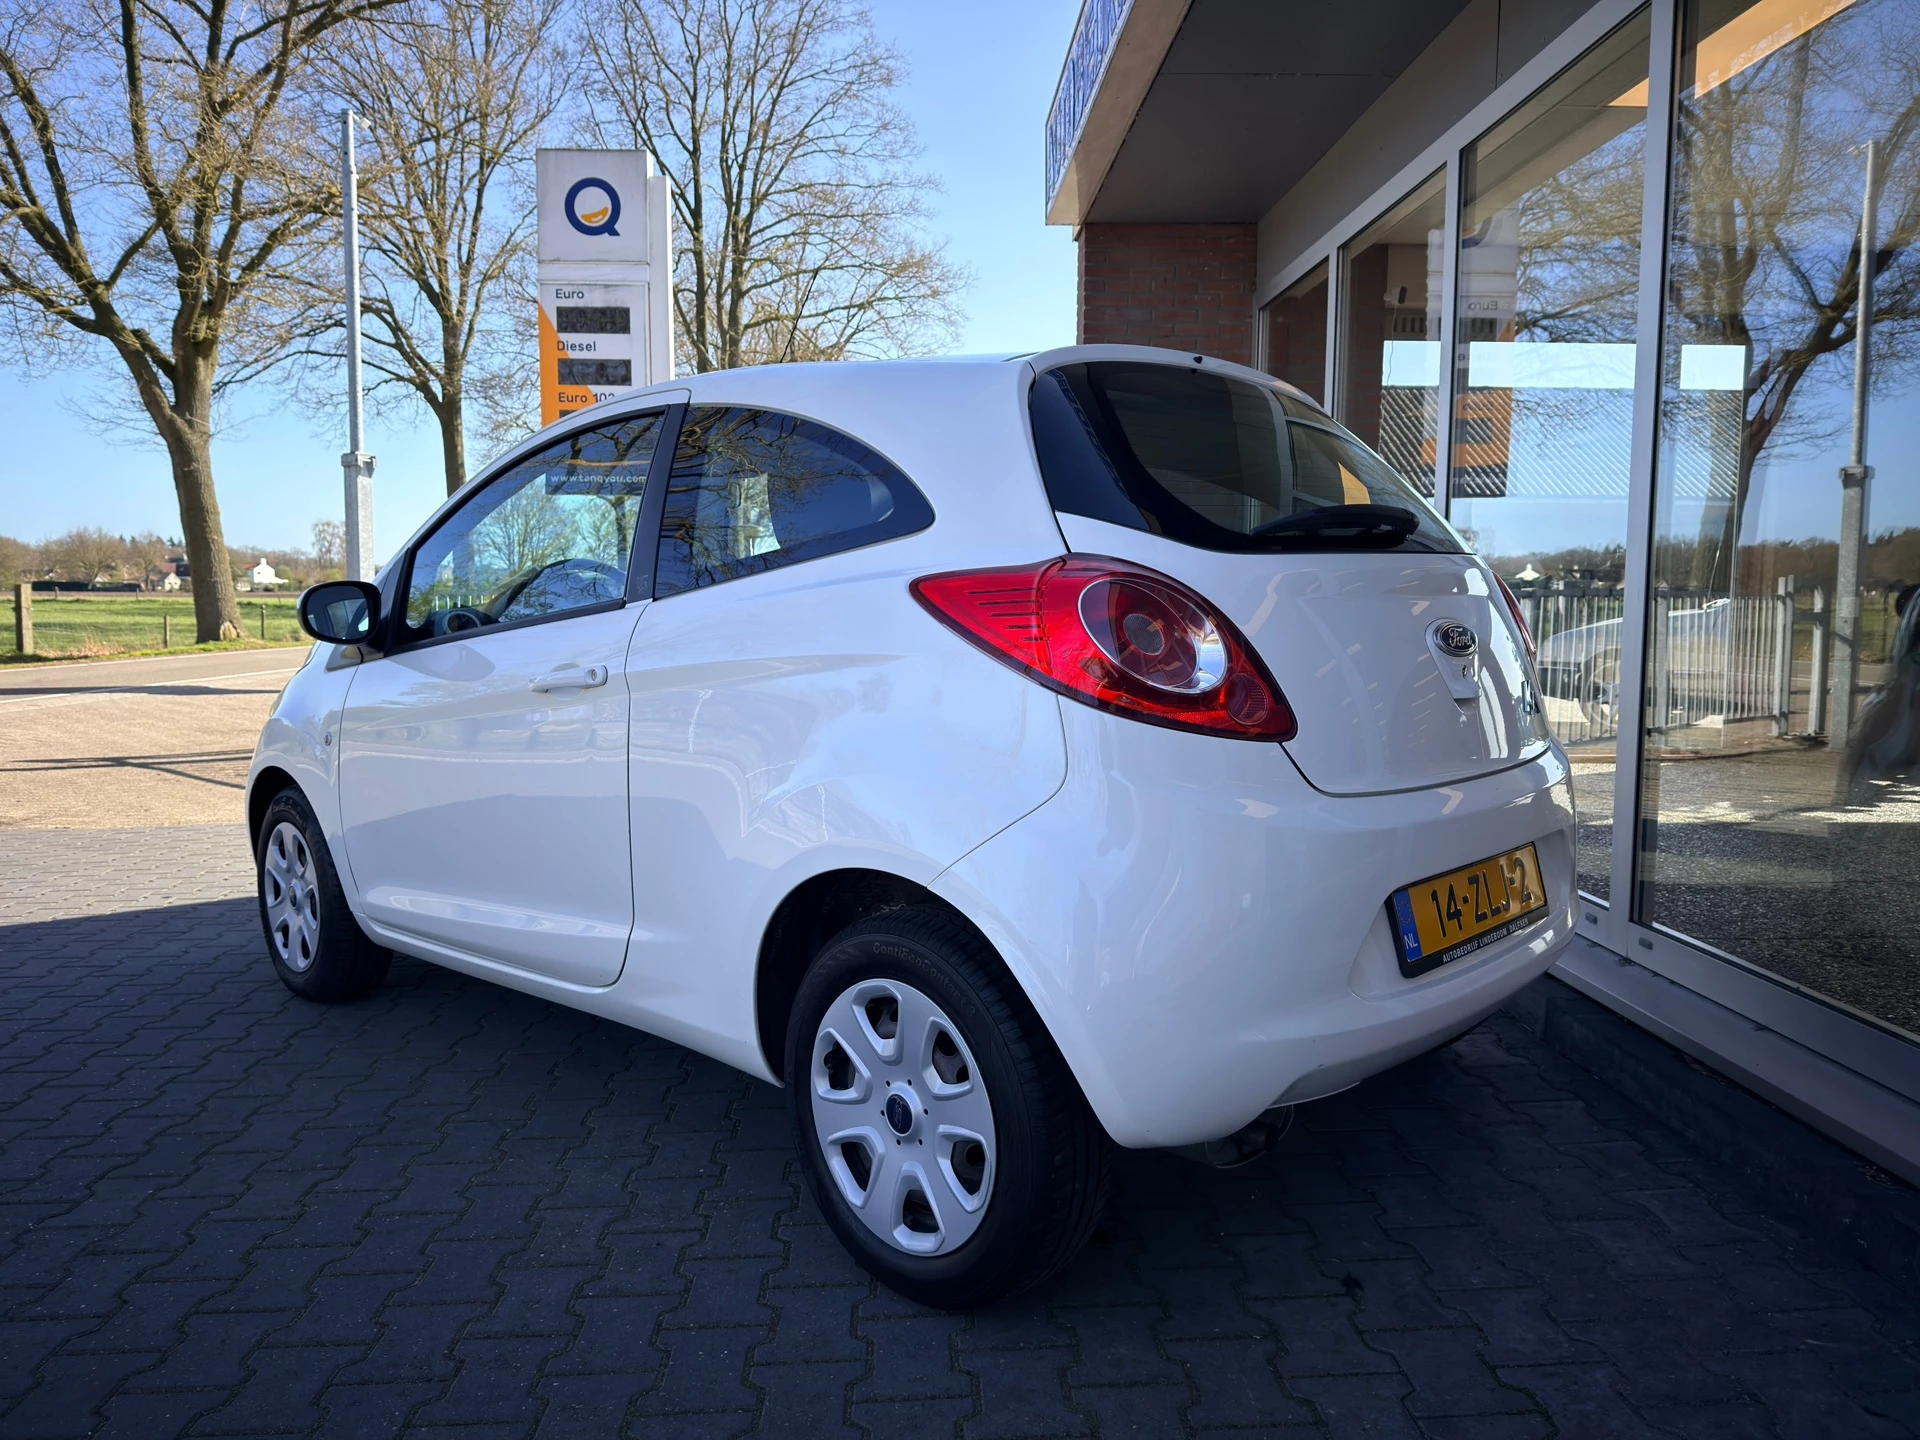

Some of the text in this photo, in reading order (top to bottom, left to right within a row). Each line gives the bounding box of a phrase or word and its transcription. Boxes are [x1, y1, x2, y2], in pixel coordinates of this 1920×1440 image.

[555, 289, 584, 299] Euro
[557, 341, 596, 351] Diesel
[558, 392, 588, 403] Euro
[1448, 627, 1473, 647] Ford
[1430, 857, 1534, 938] 14-ZLJ-2
[1404, 934, 1418, 950] NL
[1442, 941, 1479, 963] AUTOBEDRIJF
